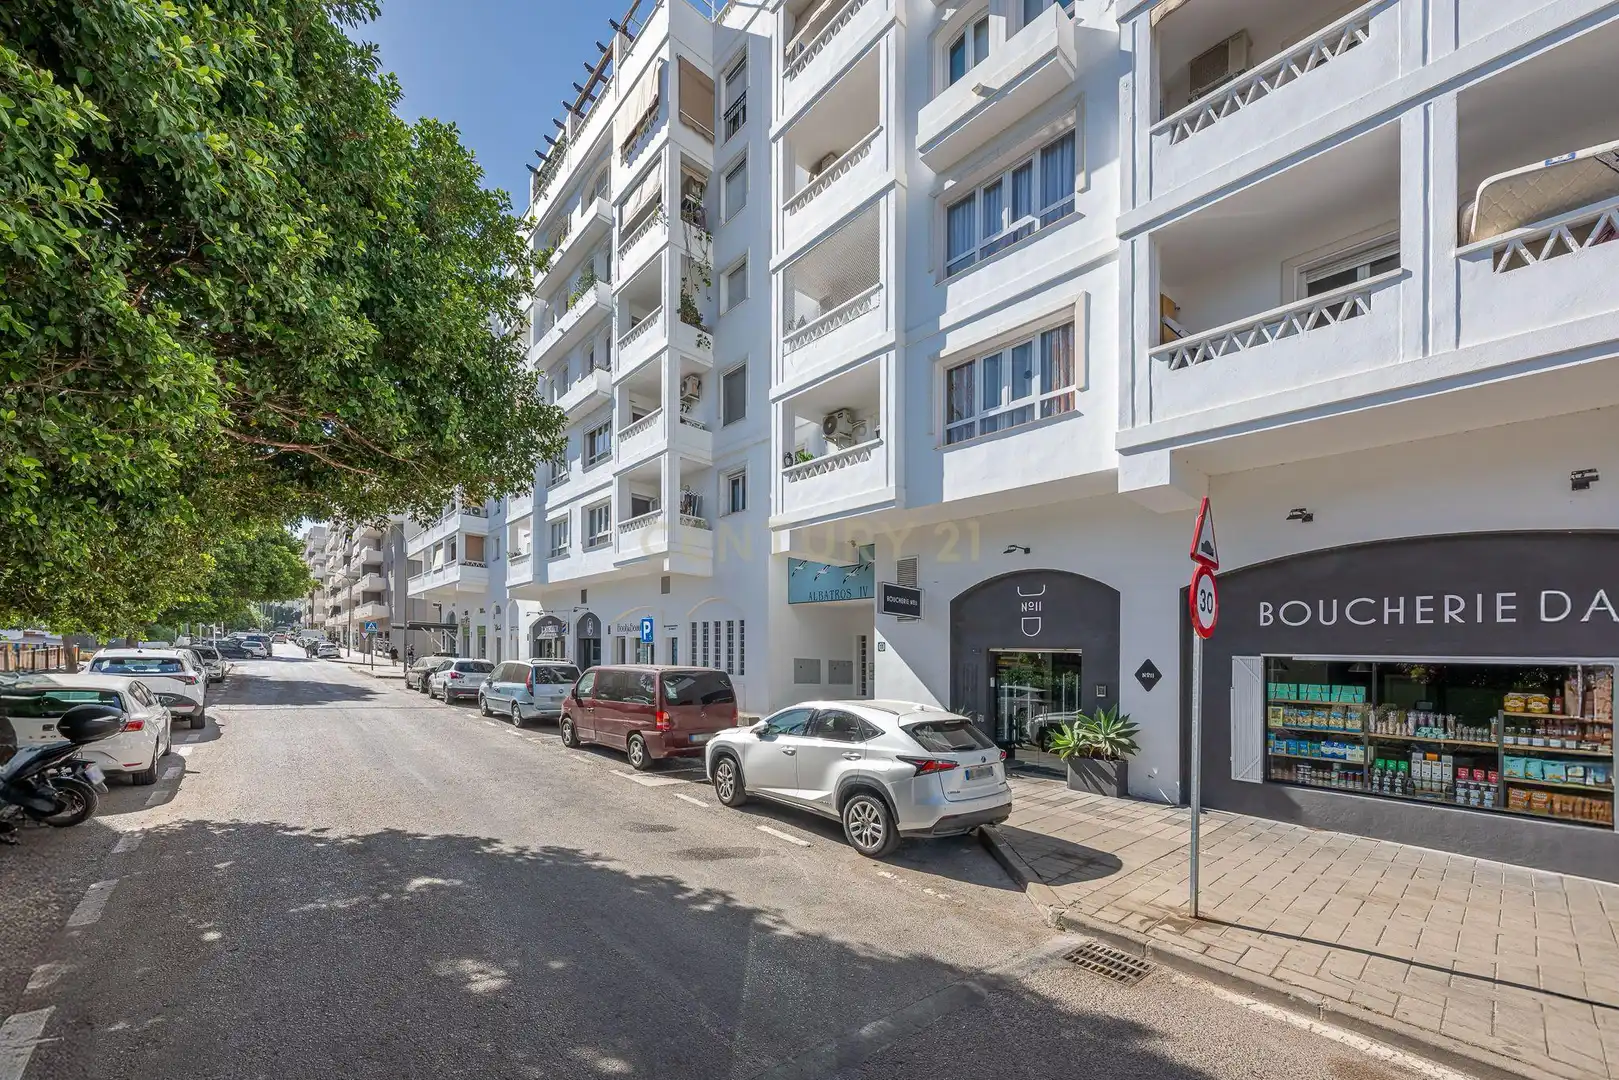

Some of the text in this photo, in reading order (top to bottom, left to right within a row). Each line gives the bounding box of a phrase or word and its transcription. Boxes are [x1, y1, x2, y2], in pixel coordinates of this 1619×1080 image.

[808, 585, 869, 601] ALBATROS IV
[1200, 588, 1214, 614] 30
[1259, 588, 1619, 627] BOUCHERIE DA
[643, 621, 651, 640] P
